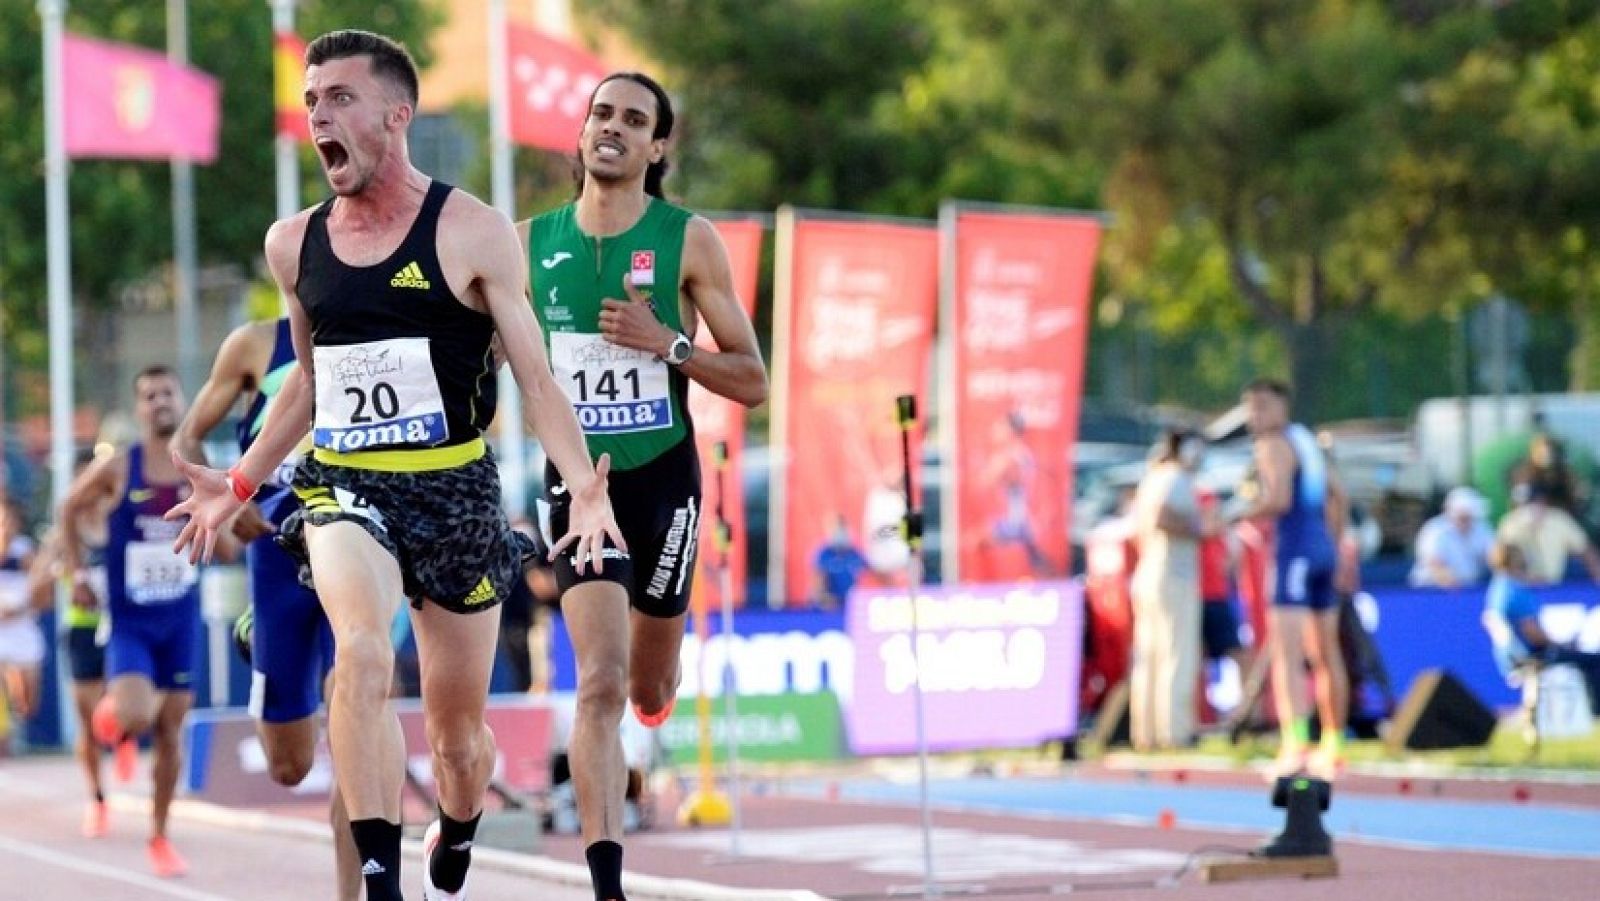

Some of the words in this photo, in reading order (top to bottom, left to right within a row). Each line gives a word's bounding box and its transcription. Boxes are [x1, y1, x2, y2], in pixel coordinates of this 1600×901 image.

[390, 277, 431, 290] adidas
[572, 367, 641, 402] 141
[344, 381, 400, 424] 20
[575, 403, 657, 427] oma
